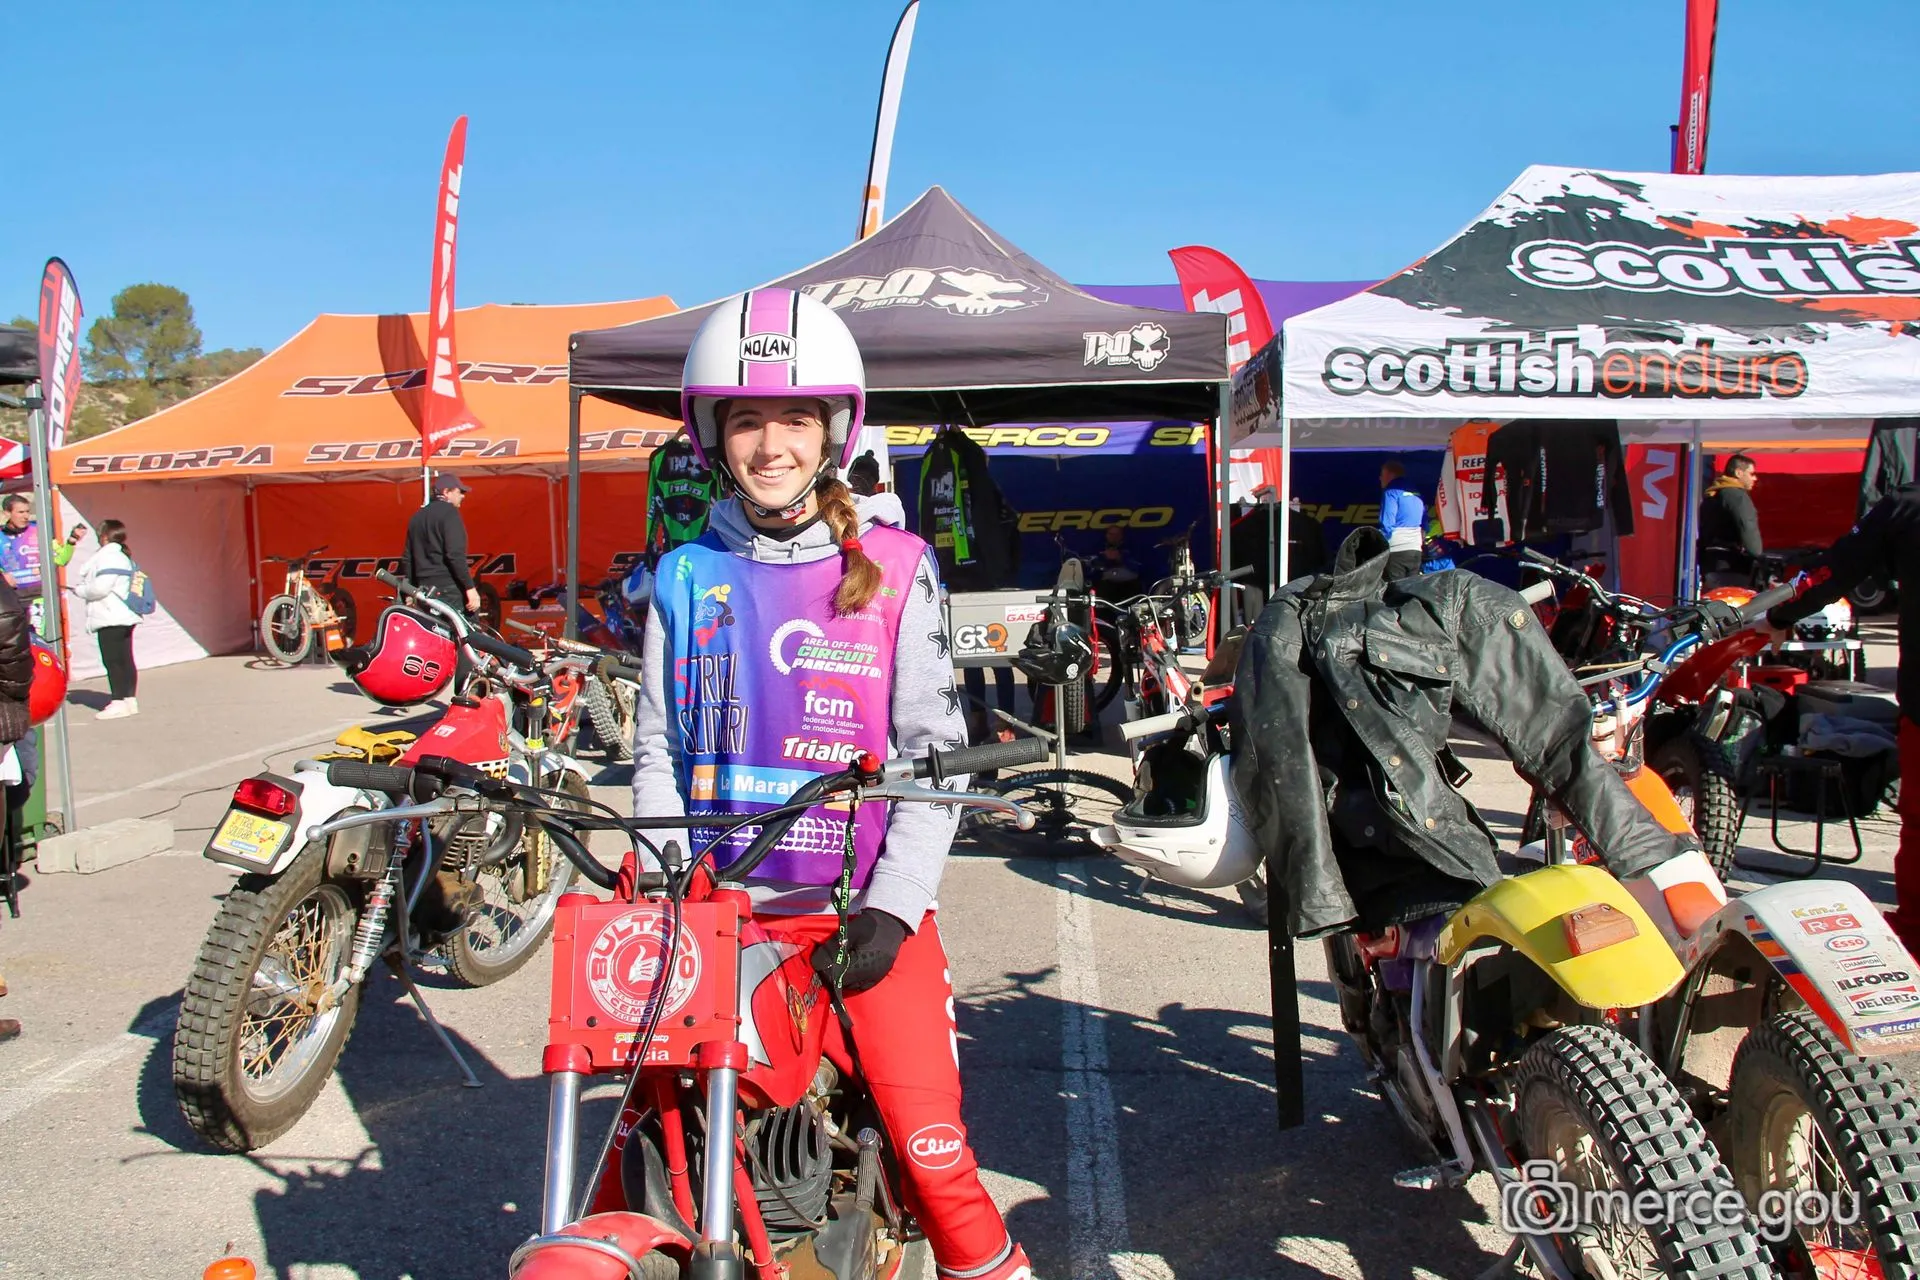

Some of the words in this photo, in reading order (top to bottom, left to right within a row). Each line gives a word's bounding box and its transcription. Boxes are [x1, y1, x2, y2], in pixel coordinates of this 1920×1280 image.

[743, 335, 791, 358] NOLAN
[1330, 342, 1594, 394] scottish
[1602, 342, 1804, 395] enduro
[71, 445, 274, 476] SCORPA
[1017, 506, 1174, 533] ERCO
[797, 645, 877, 666] CIRCUIT
[802, 637, 830, 649] AREA
[831, 640, 879, 654] OFF-ROAD
[804, 691, 855, 719] fcm
[801, 723, 811, 731] de
[802, 715, 835, 726] federació
[836, 719, 865, 731] catalana
[734, 773, 800, 795] Marat
[1791, 903, 1849, 919] Km.2
[1843, 956, 1881, 969] CHAMPION
[1837, 970, 1911, 991] ILFORD
[610, 995, 674, 1016] CEMOO
[1880, 1022, 1920, 1035] MICHE
